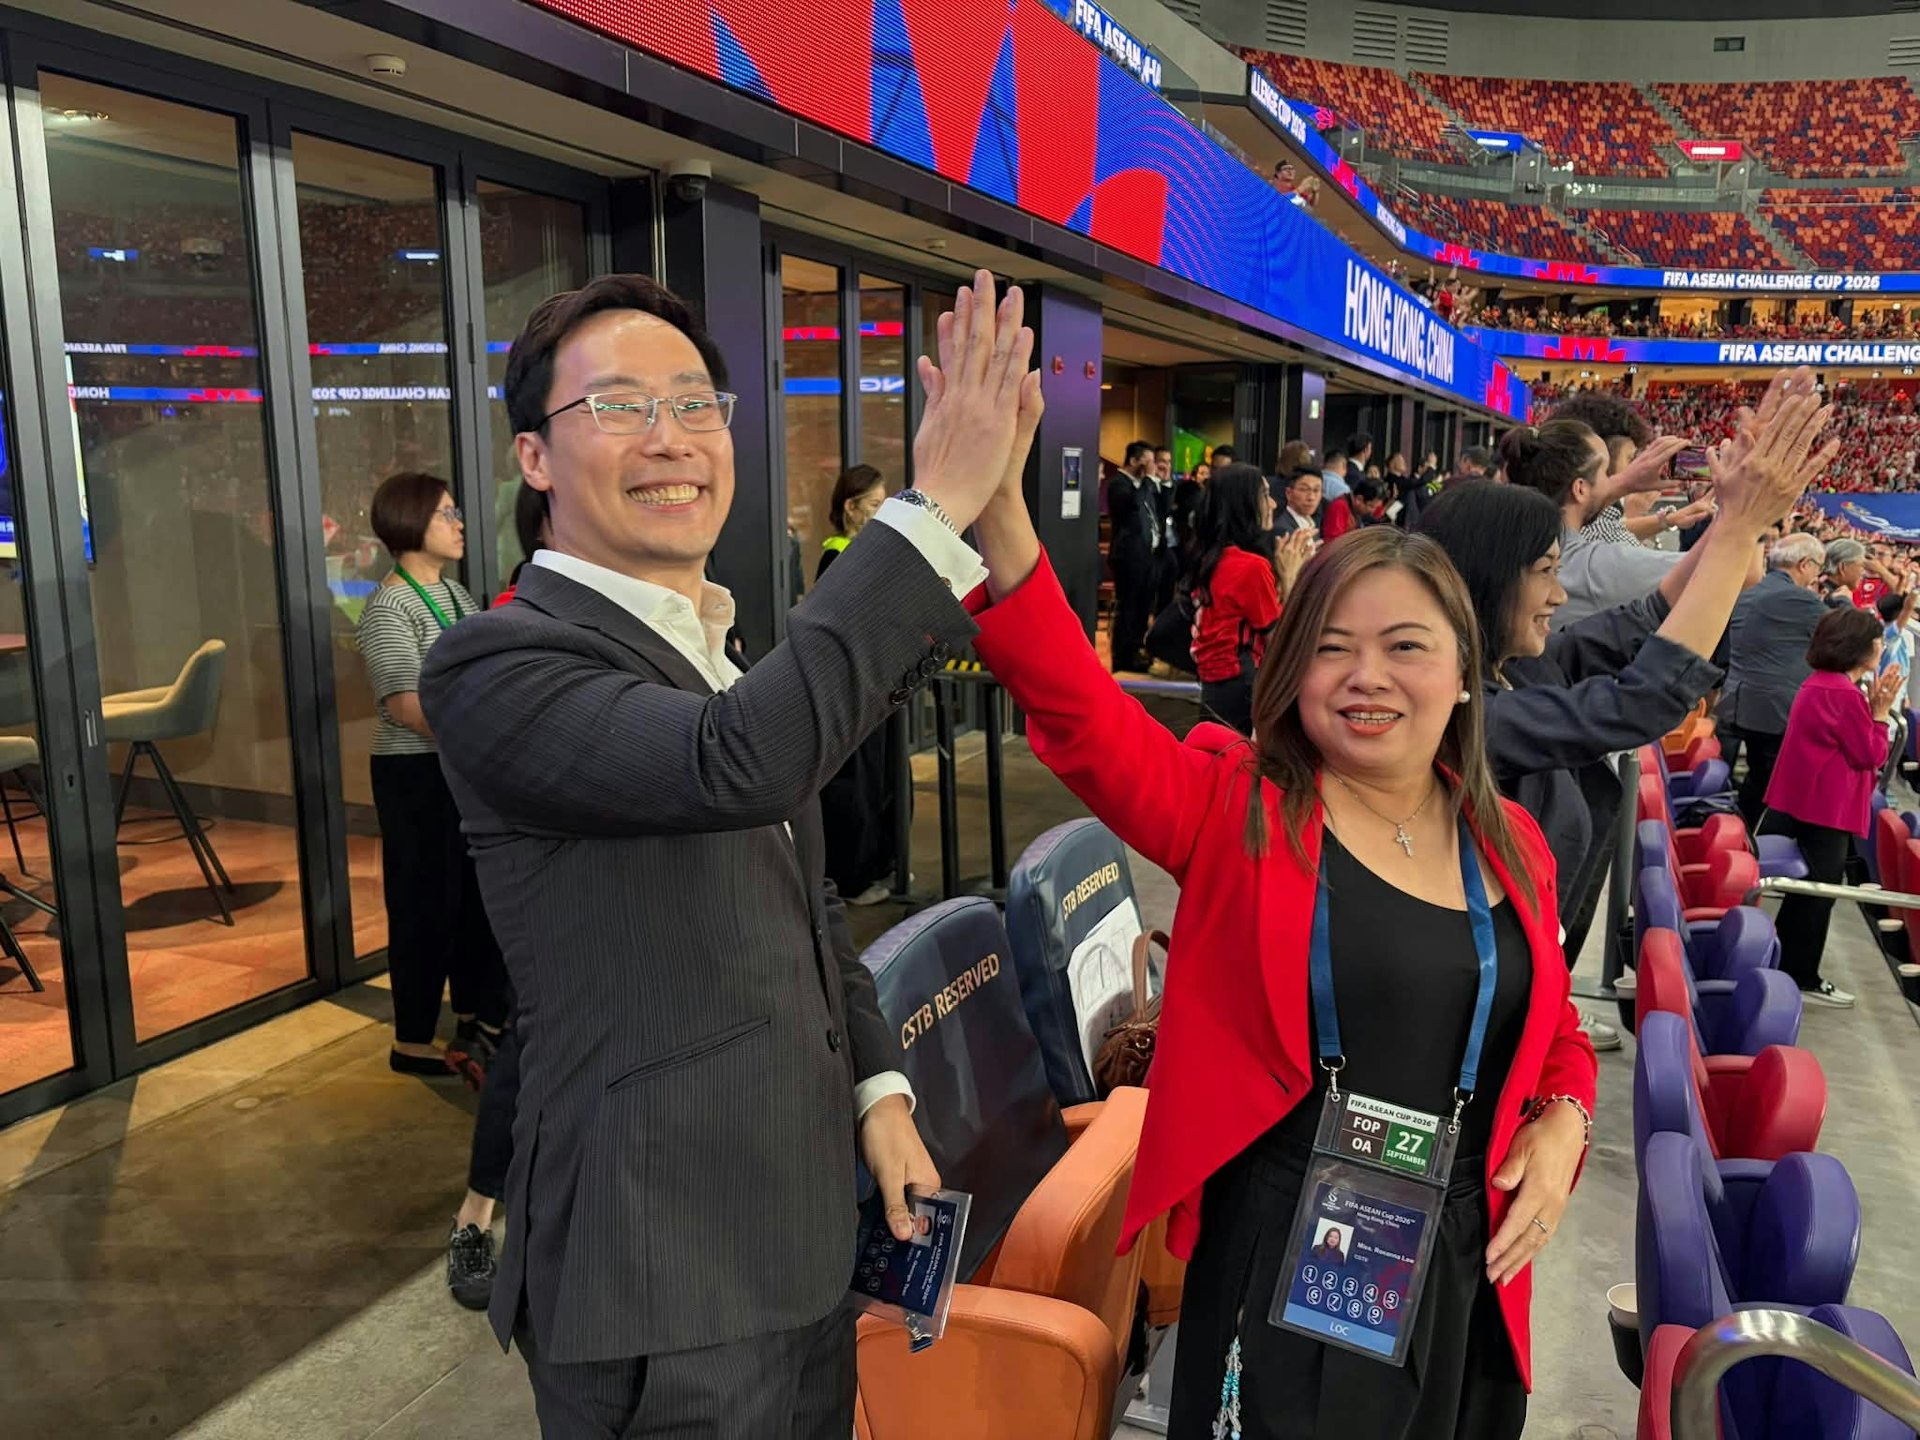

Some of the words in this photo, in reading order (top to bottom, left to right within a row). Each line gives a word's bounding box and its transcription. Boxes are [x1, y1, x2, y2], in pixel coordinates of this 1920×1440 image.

[1663, 271, 1688, 287] FIFA
[1690, 272, 1735, 288] ASEAN
[1736, 273, 1812, 289] CHALLENGE
[1814, 275, 1843, 290] CUP
[1844, 275, 1880, 290] 2026
[1344, 259, 1392, 355] HONG
[1391, 294, 1426, 380] KONG,
[1426, 319, 1454, 385] CHINA
[1719, 344, 1757, 361] FIFA
[1759, 344, 1822, 362] ASEAN
[1824, 344, 1920, 362] CHALLENG
[1076, 862, 1119, 905] RESERVED
[902, 1003, 934, 1050] CSTB
[934, 953, 1000, 1019] RESERVED
[1350, 1100, 1367, 1110] FIFA
[1368, 1104, 1395, 1116] ASEAN
[1395, 1112, 1411, 1121] CUP
[1353, 1116, 1381, 1133] FOP
[1351, 1137, 1372, 1153] OA
[1395, 1131, 1424, 1153] 27
[1386, 1149, 1427, 1167] SEPTEMBER
[1344, 1200, 1359, 1210] FIFA
[1359, 1205, 1381, 1215] ASEAN
[1329, 1321, 1350, 1336] LOC
